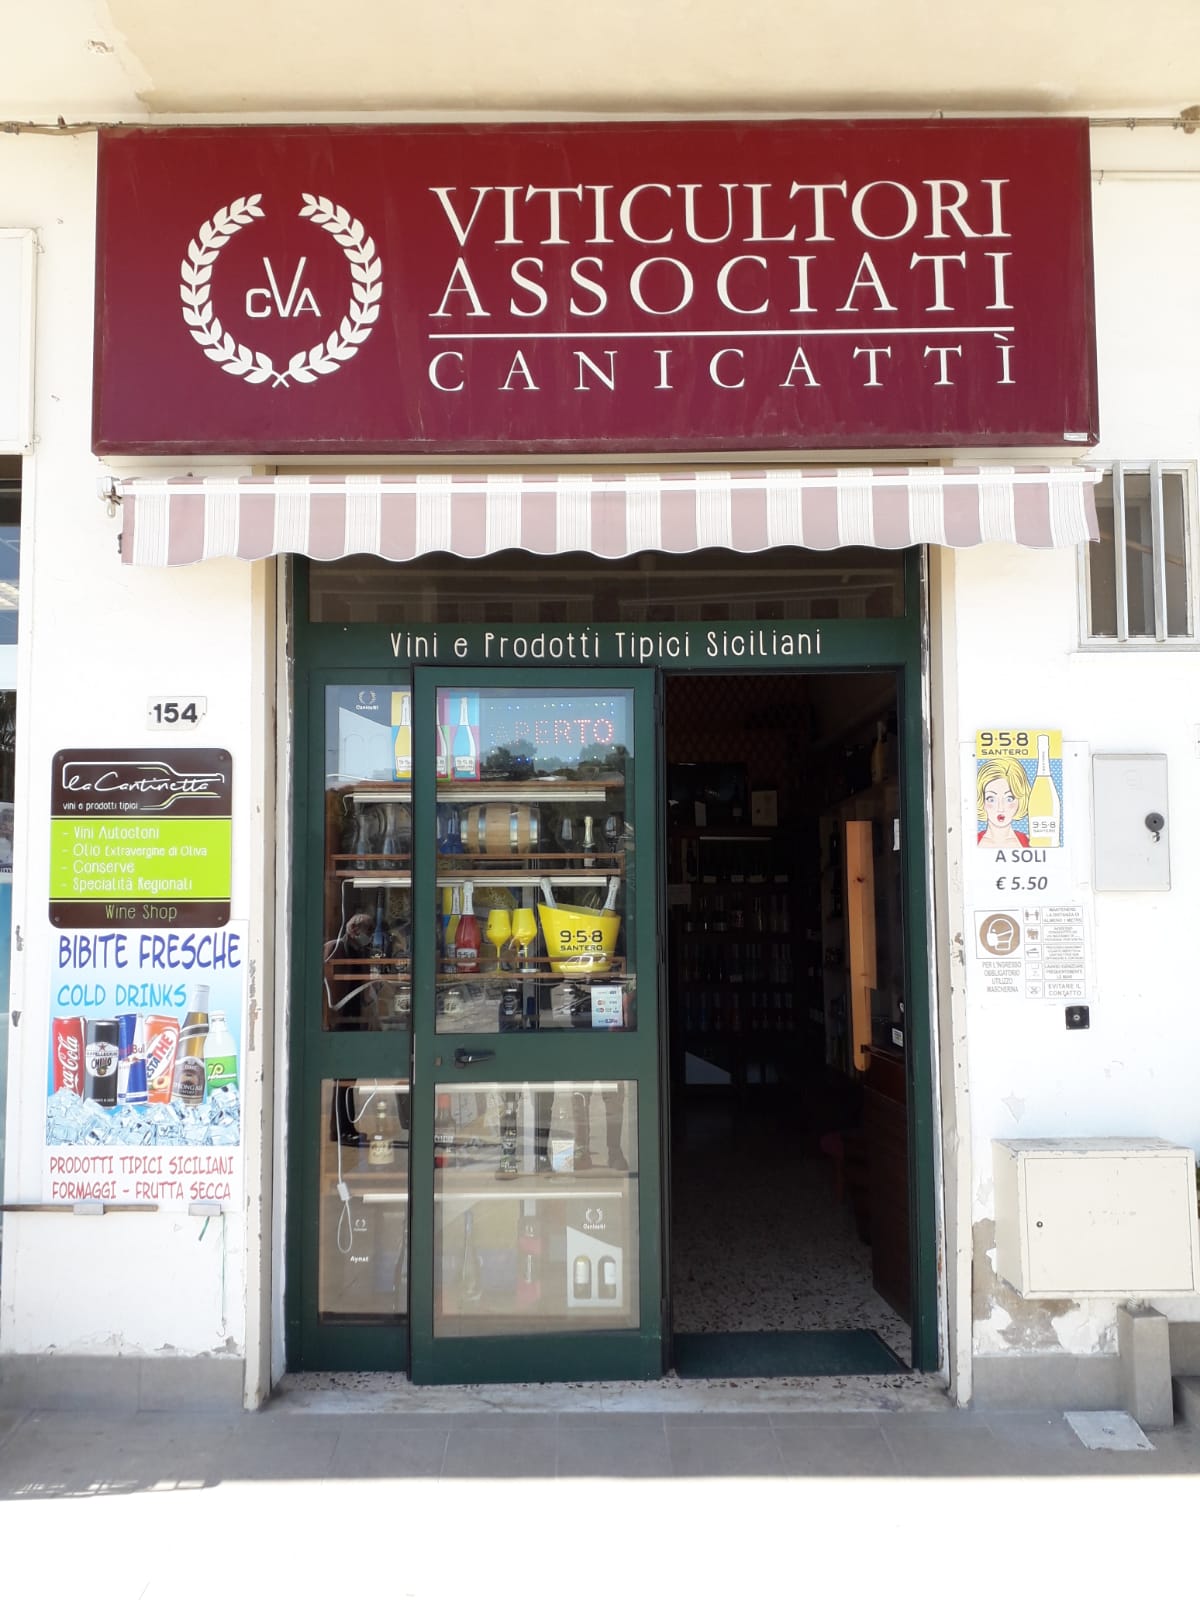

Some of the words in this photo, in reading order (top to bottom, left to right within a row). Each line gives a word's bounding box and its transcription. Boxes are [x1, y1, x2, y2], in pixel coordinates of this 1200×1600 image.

[428, 178, 1012, 246] VITICULTORI
[435, 251, 1014, 316] ASSOCIATI
[428, 332, 1017, 393] CANICATTÌ
[390, 632, 438, 658] Vini
[454, 637, 469, 657] e
[484, 626, 600, 659] Prodotti
[615, 631, 690, 664] Tipici
[706, 628, 822, 658] Siciliani
[153, 702, 198, 724] 154
[981, 748, 1029, 756] SANTERO
[94, 771, 212, 793] Cantinetta
[63, 802, 75, 810] vini
[86, 801, 117, 812] prodotti
[119, 801, 138, 812] tipici
[73, 826, 94, 840] Vini
[98, 825, 160, 840] Autoctoni
[73, 843, 101, 857] Olio
[105, 844, 165, 859] Extravergine
[168, 845, 178, 856] di
[180, 845, 208, 857] Oliva
[995, 849, 1007, 863] A
[1011, 849, 1047, 863] SOLI
[73, 859, 135, 875] Conserve
[73, 876, 133, 893] Specialità
[137, 877, 193, 894] Regionali
[996, 876, 1007, 890] €
[1011, 876, 1048, 890] 5.50
[105, 904, 137, 919] Wine
[142, 904, 178, 922] Shop
[59, 933, 128, 968] BIBITE
[139, 932, 241, 970] FRESCHE
[560, 944, 603, 952] SANTERO
[57, 984, 106, 1007] COLD
[116, 984, 187, 1007] DRINKS
[50, 1156, 113, 1174] PRODOTTI
[120, 1156, 163, 1174] TIPICI
[169, 1156, 234, 1175] SICILIANI
[52, 1181, 117, 1199] FORMAGGI
[135, 1181, 184, 1199] FRUTTA
[189, 1181, 231, 1199] SECCA
